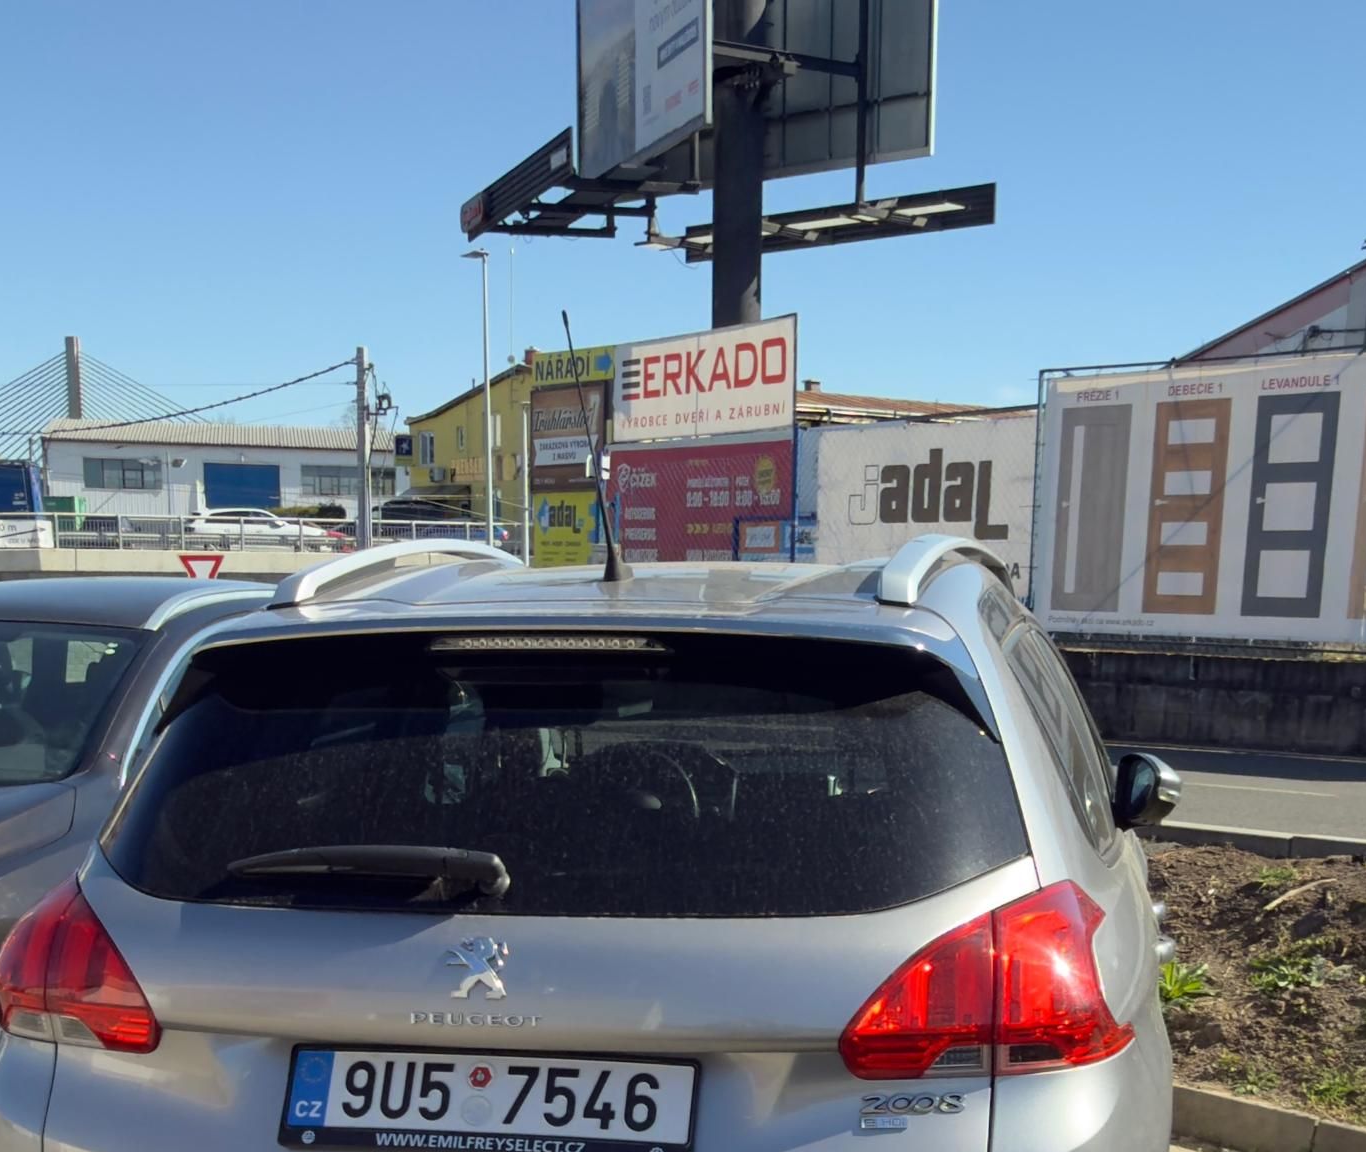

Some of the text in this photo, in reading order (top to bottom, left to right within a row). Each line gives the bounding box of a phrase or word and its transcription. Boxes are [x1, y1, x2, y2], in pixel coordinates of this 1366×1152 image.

[535, 351, 590, 381] NÁŘADÍ
[643, 337, 787, 399] ERKADO
[1168, 384, 1214, 396] DEBECIE
[1261, 374, 1331, 391] LEVANDULE
[621, 400, 786, 429] VÝROBCE DVEŘÍ A ZÁRUBNÍ
[410, 1011, 544, 1028] PEUGEOT
[341, 1060, 661, 1132] 9U5 7546
[859, 1091, 967, 1115] 2008
[294, 1099, 323, 1118] CZ
